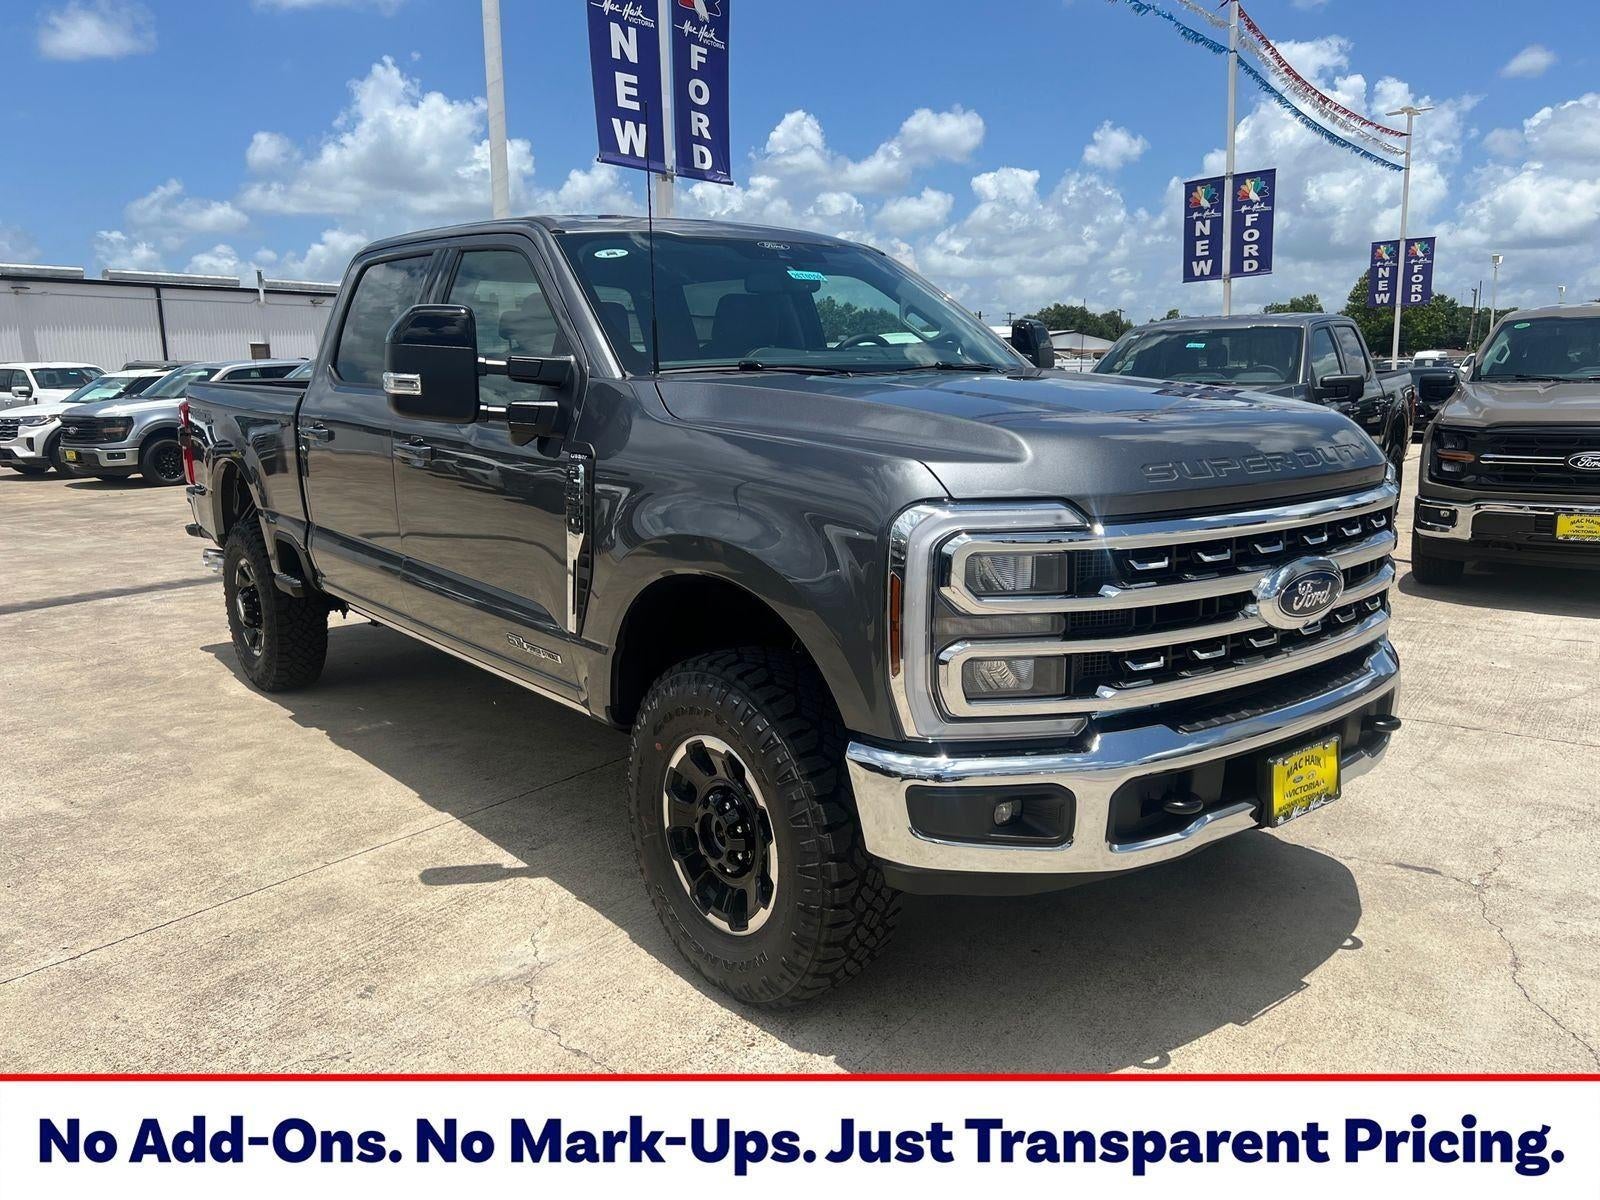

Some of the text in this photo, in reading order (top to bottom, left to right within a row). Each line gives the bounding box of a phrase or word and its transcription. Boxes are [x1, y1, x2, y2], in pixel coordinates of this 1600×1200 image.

[628, 16, 655, 28] VICTORIA
[703, 38, 726, 50] VICTORIA
[609, 22, 647, 158] NEW
[688, 43, 713, 170] FORD
[1191, 219, 1213, 277] NEW
[1242, 213, 1260, 273] FORD
[1375, 267, 1390, 304] NEW
[1410, 264, 1424, 303] FORD
[1291, 578, 1332, 611] Ford
[1285, 757, 1304, 781] MAC
[1304, 754, 1322, 768] HAIK
